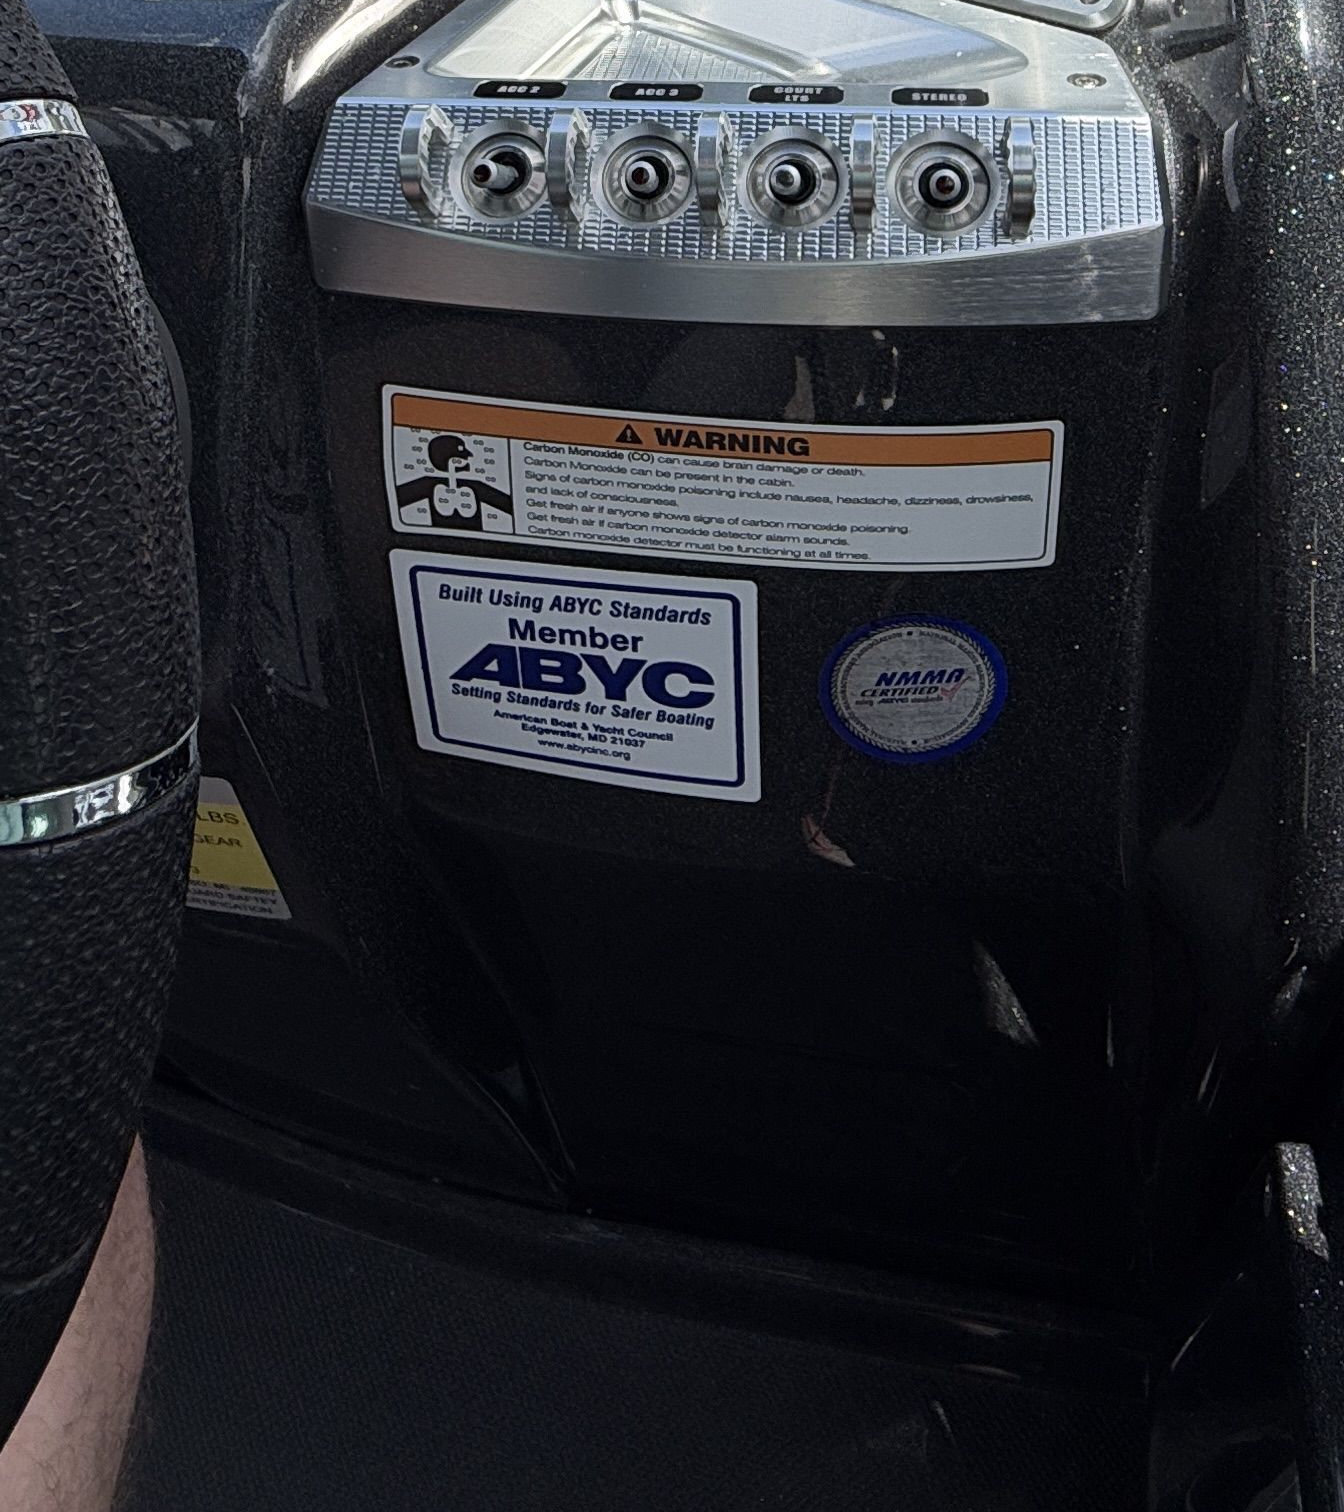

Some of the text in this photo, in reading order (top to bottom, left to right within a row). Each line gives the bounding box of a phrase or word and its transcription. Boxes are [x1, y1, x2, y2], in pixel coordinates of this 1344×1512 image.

[528, 85, 541, 94] 2
[668, 88, 679, 96] 3
[911, 92, 968, 101] STEREO
[653, 427, 810, 457] WARNING
[523, 442, 565, 454] Carbon
[569, 446, 624, 460] Monoxide
[627, 450, 654, 464] (CO)
[658, 456, 680, 465] can
[683, 459, 719, 468] cause
[723, 460, 753, 470] brain
[756, 463, 808, 475] damage
[827, 468, 865, 476] death.
[524, 456, 795, 487] Carbon Monoxide can be present in the cabin.
[524, 470, 557, 482] Signs
[559, 474, 570, 483] of
[573, 475, 614, 487] carbon
[617, 480, 676, 492] monoxide
[679, 486, 736, 499] poisoning
[739, 488, 782, 501] include
[837, 496, 901, 506] headache,
[905, 496, 962, 506] dizziness,
[966, 494, 1033, 504] drowsiness,
[526, 485, 679, 507] and lack of consciousness.
[526, 498, 547, 509] Get
[550, 500, 578, 511] fresh
[582, 504, 595, 513] air
[607, 508, 649, 520] anyone
[653, 512, 690, 522] shows
[694, 514, 724, 525] signs
[728, 516, 739, 525] of
[742, 518, 784, 529] carbon
[787, 522, 847, 533] monoxide
[527, 512, 548, 522] Get
[551, 514, 579, 525] fresh
[582, 518, 595, 526] air
[608, 521, 648, 532] carbon
[652, 525, 710, 537] monoxide
[713, 530, 762, 541] detector
[766, 534, 800, 543] alarm
[528, 525, 570, 537] Carbon
[573, 530, 630, 543] monoxide
[634, 535, 682, 548] detector
[685, 542, 715, 551] must
[718, 543, 733, 552] be
[737, 545, 801, 558] functioning
[805, 550, 816, 558] at
[819, 550, 832, 558] all
[438, 583, 711, 626] Built Using ABYC Standards
[508, 618, 644, 652] Member
[449, 643, 715, 709] ABYC
[861, 686, 940, 697] CERTIFIED
[875, 668, 966, 687] NMMA
[452, 683, 714, 730] Setting Standards for Safer Boating
[493, 709, 673, 741] American Boat & Yacht Council
[588, 733, 607, 744] MD
